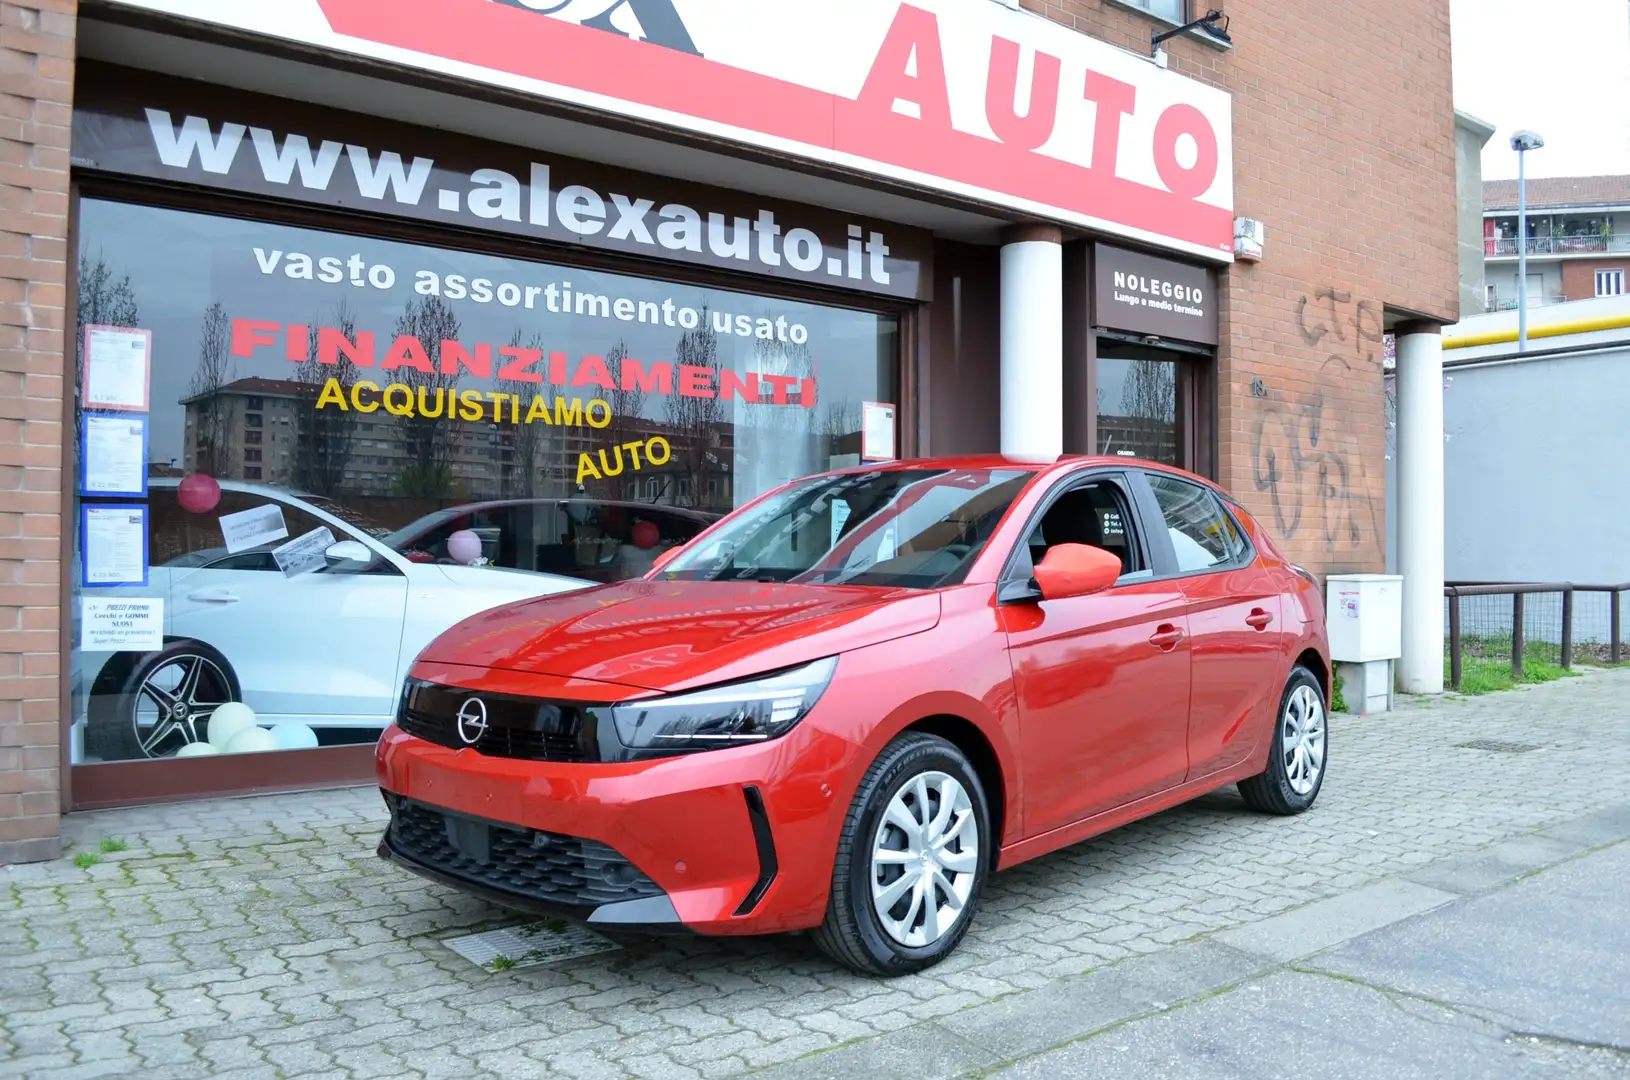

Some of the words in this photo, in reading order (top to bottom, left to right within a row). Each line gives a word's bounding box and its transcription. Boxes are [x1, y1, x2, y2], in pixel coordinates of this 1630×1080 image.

[855, 2, 1218, 199] AUTO
[144, 107, 892, 286] www.alexauto.it
[253, 246, 396, 291] vasto
[414, 268, 699, 330] assortimento
[712, 309, 809, 345] usato
[1114, 271, 1203, 304] NOLEGGIO
[1114, 291, 1140, 306] Lungo
[1141, 298, 1147, 306] e
[1148, 299, 1173, 312] medio
[1174, 303, 1204, 317] termine
[232, 318, 816, 408] FINANZIAMENTI
[315, 377, 612, 429] ACQUISTIAMO
[576, 436, 671, 484] AUTO
